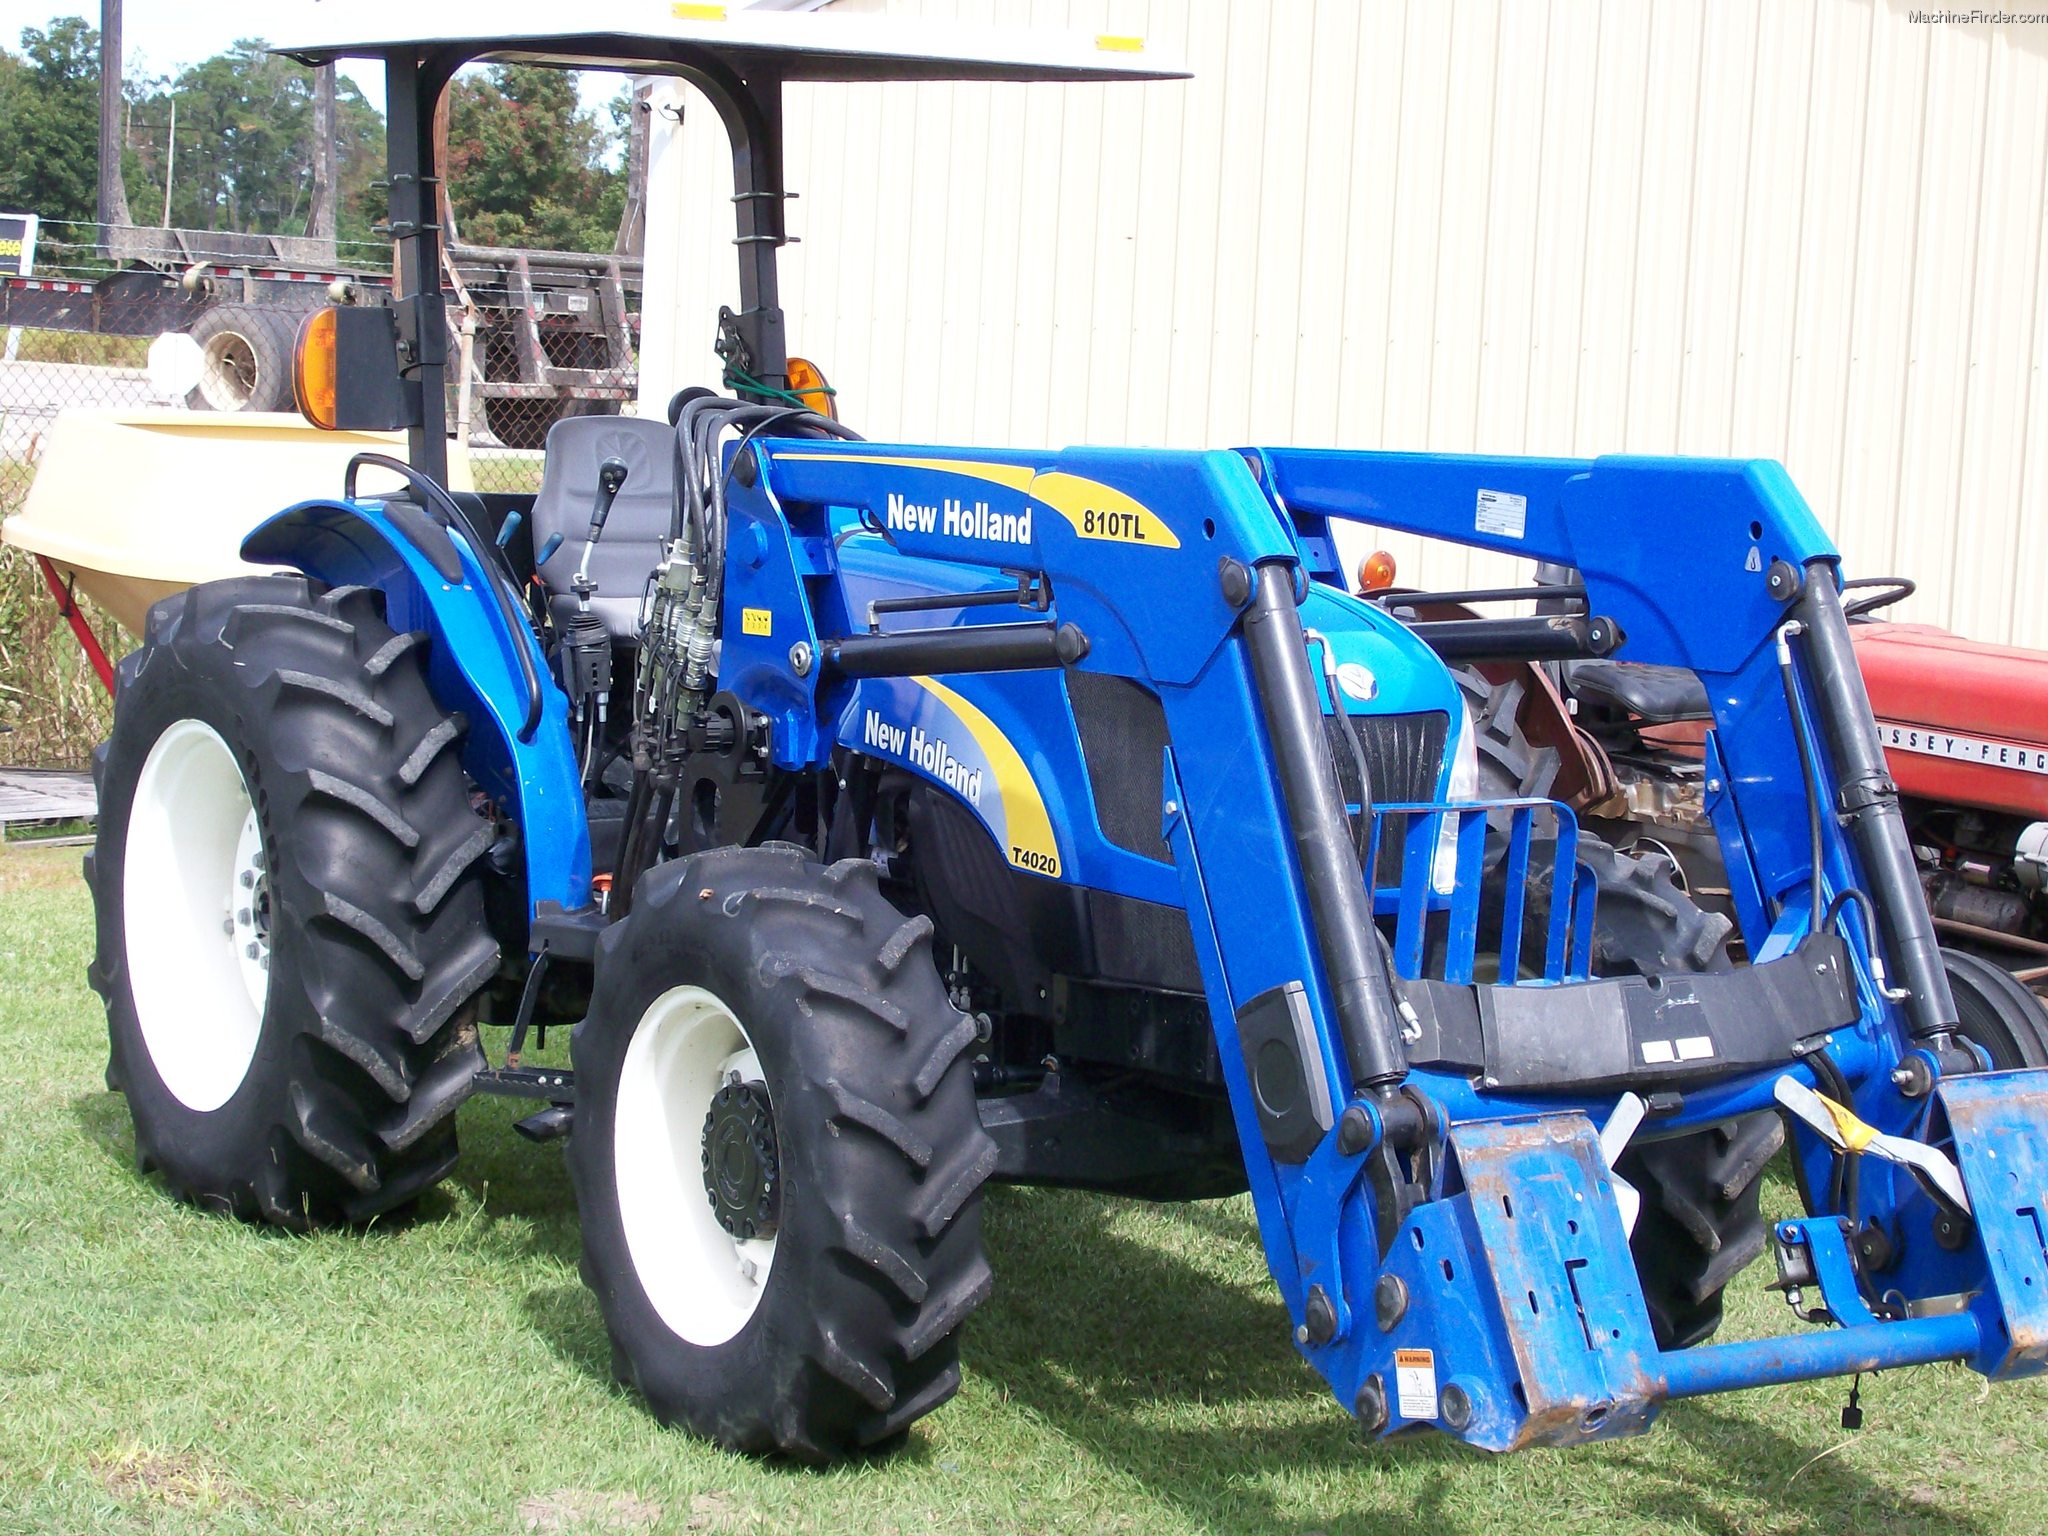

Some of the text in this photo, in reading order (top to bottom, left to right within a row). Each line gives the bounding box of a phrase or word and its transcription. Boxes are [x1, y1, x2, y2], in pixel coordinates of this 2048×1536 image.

[887, 493, 1032, 545] New Holland
[1084, 509, 1146, 540] 810TL
[864, 709, 983, 807] New Holland
[1012, 847, 1056, 874] T4020
